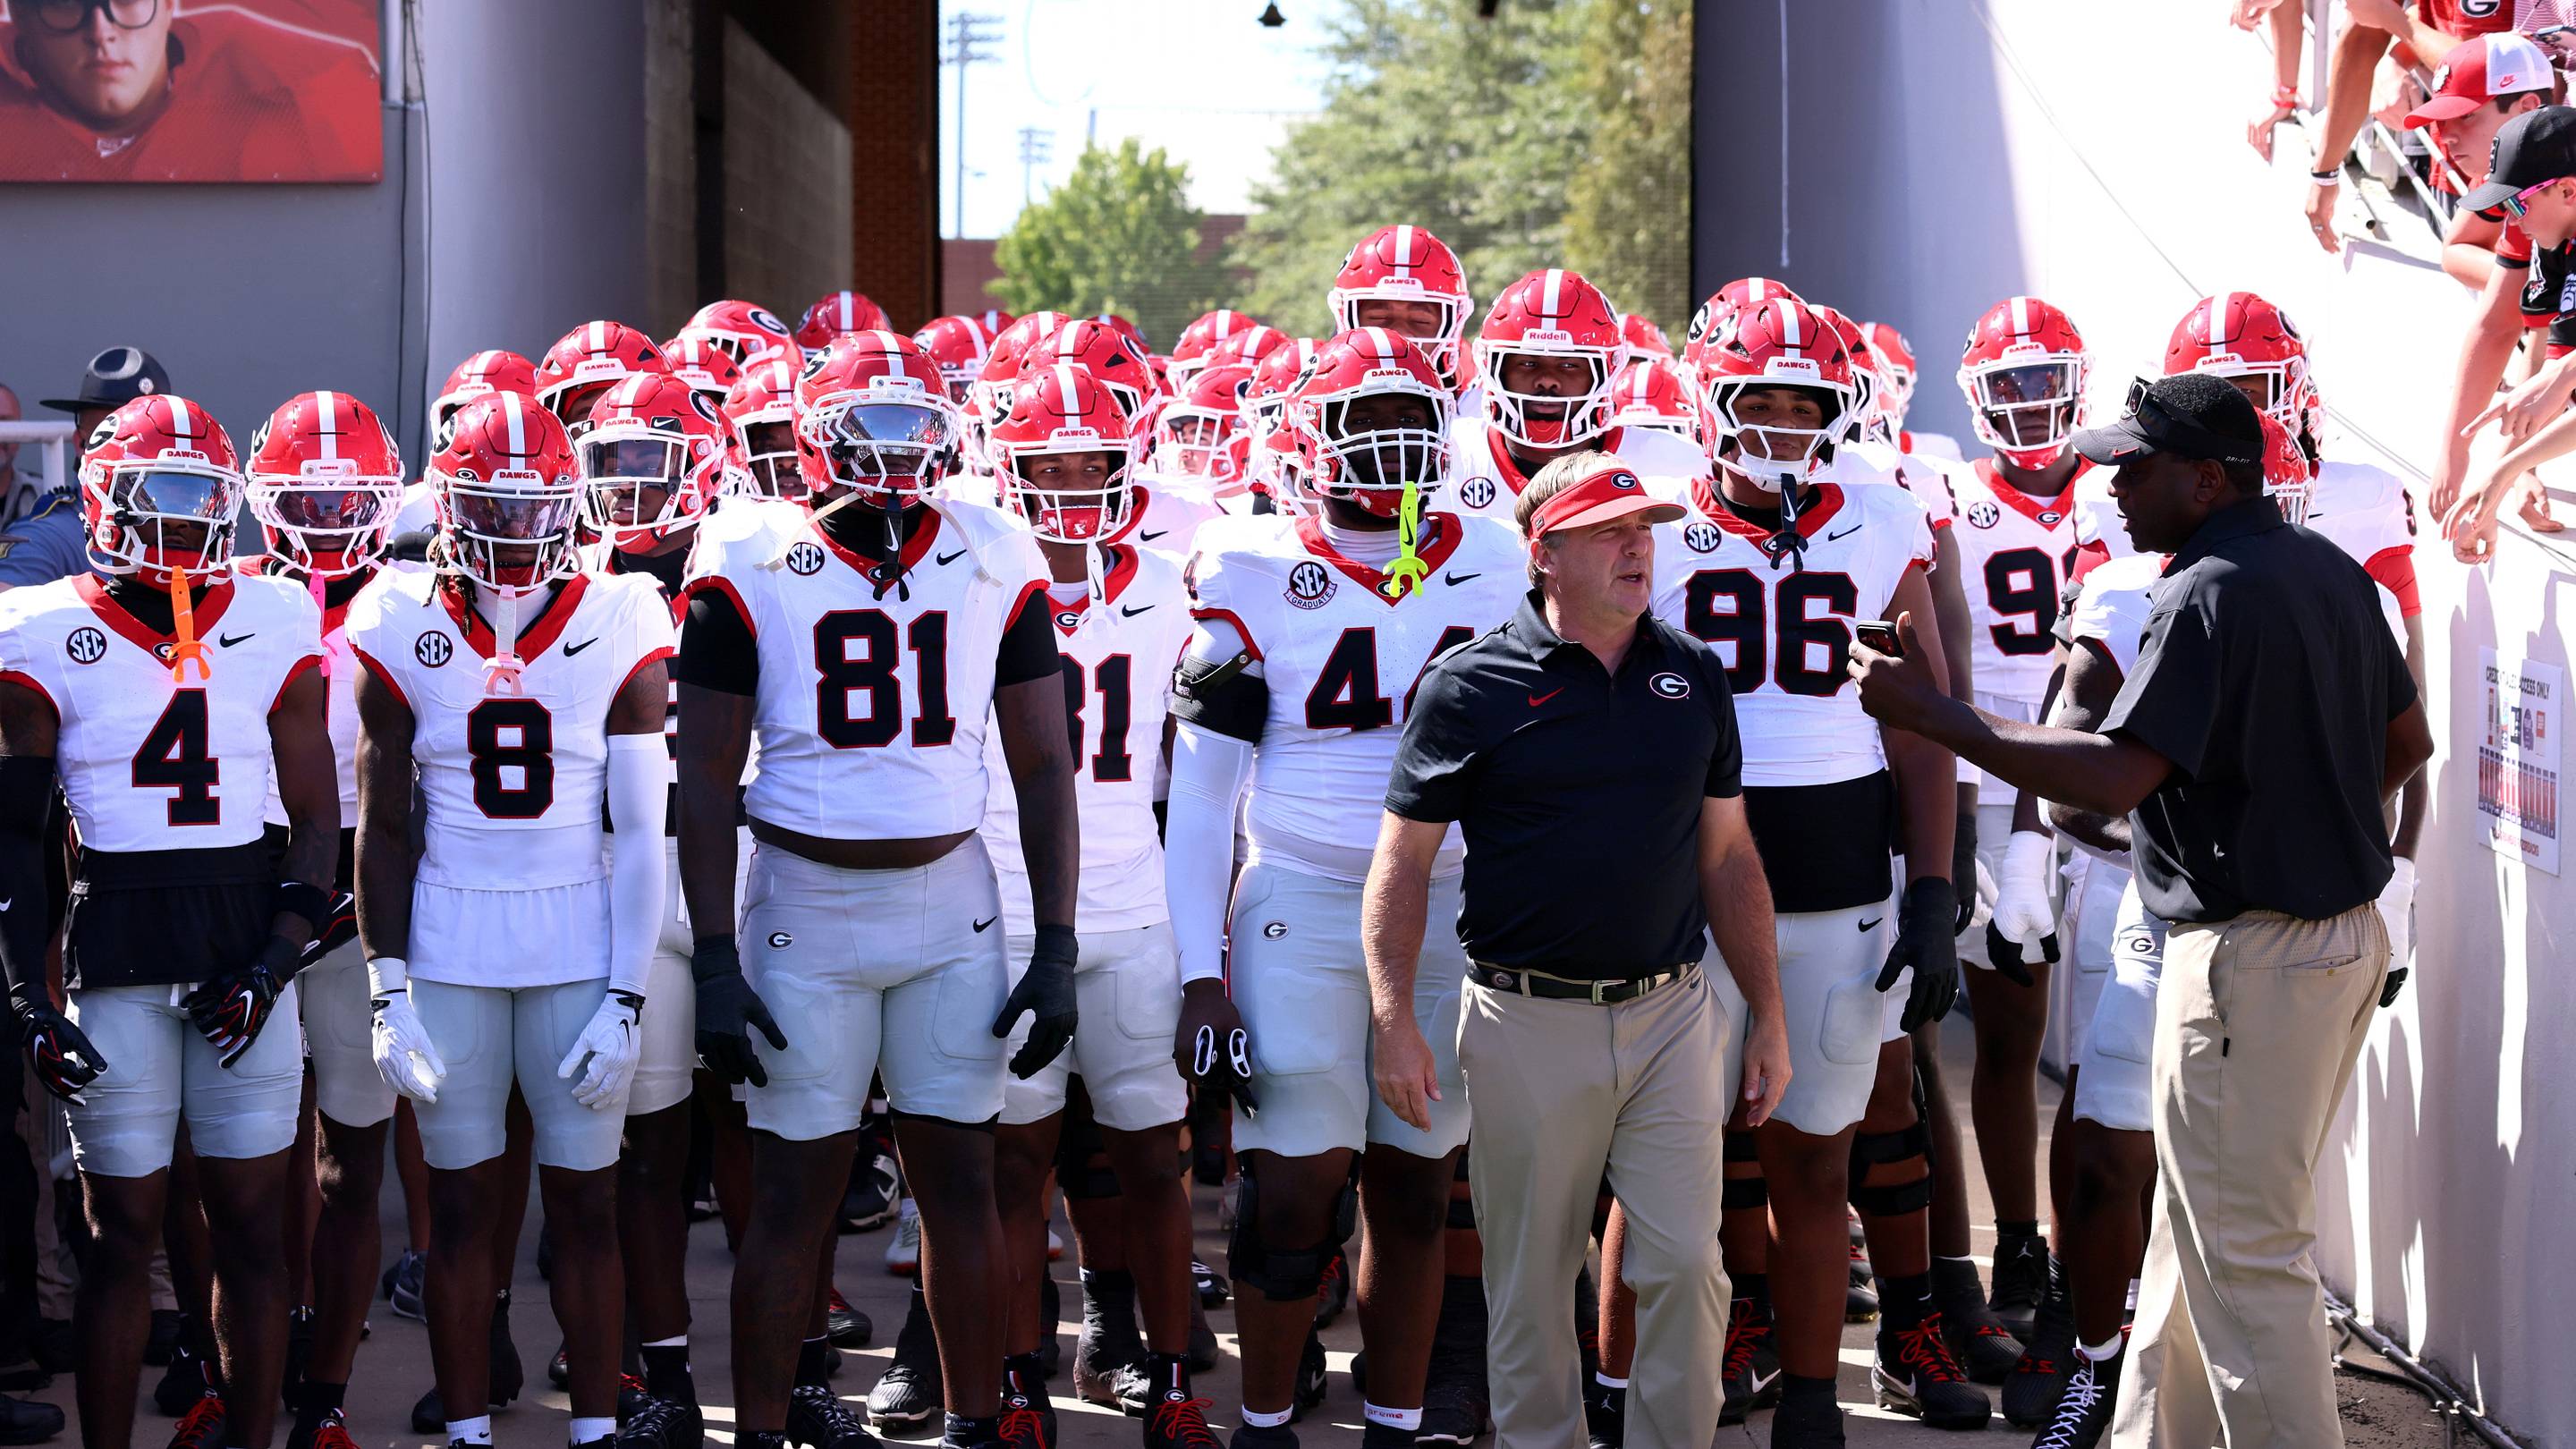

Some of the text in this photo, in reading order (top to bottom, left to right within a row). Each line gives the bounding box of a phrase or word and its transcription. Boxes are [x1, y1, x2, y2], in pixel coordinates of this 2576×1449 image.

[1529, 332, 1567, 342] Riddell
[2009, 344, 2039, 352] DAWGS
[584, 362, 615, 371] DAWGS
[1776, 361, 1811, 369] DAWGS
[2202, 356, 2236, 365] DAWGS
[1371, 369, 1408, 377] DAWGS
[606, 419, 638, 427] DAWGS
[1057, 429, 1091, 437] DAWGS
[166, 451, 204, 460] DAWGS
[2225, 455, 2250, 463] DRI-FIT
[499, 471, 537, 479] DAWGS
[1613, 474, 1635, 488] G
[1462, 477, 1494, 508] SEC
[1969, 502, 1998, 529] SEC
[2038, 512, 2061, 524] G
[1687, 523, 1718, 551] SEC
[789, 543, 822, 573] SEC
[1292, 564, 1326, 597] SEC
[1291, 591, 1333, 609] GRADUATE
[1983, 544, 2080, 657] 9
[1055, 612, 1080, 627] G
[1685, 568, 1858, 697] 96
[69, 630, 104, 662] SEC
[418, 632, 450, 665] SEC
[813, 608, 956, 750] 81
[1653, 674, 1690, 697] G
[131, 688, 220, 826] 4
[467, 699, 554, 819] 8
[1263, 921, 1289, 939] G
[767, 931, 793, 949] G
[2131, 937, 2155, 953] G
